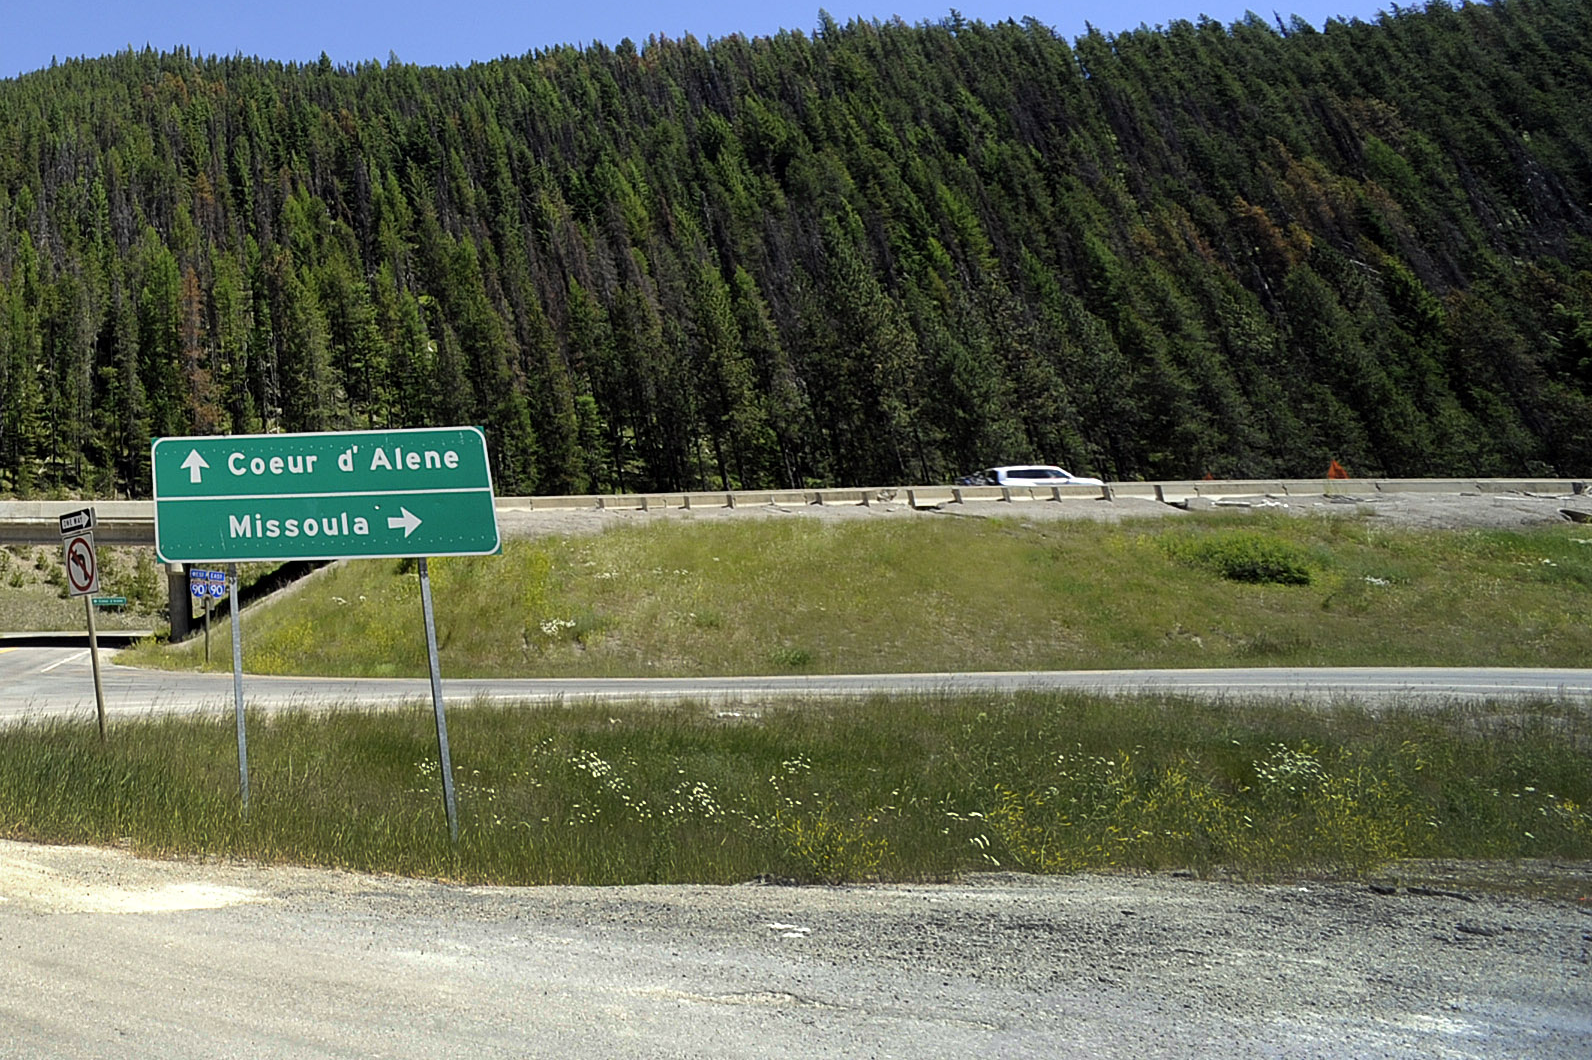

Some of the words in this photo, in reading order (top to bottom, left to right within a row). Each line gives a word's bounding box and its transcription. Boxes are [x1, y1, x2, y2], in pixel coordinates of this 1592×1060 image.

[227, 452, 318, 476] Coeur
[337, 444, 359, 472] d'
[369, 447, 460, 471] Alene
[63, 518, 73, 528] ONE
[73, 516, 83, 525] WAY
[228, 512, 370, 539] Missoula
[192, 584, 205, 595] 90
[210, 584, 223, 595] 90
